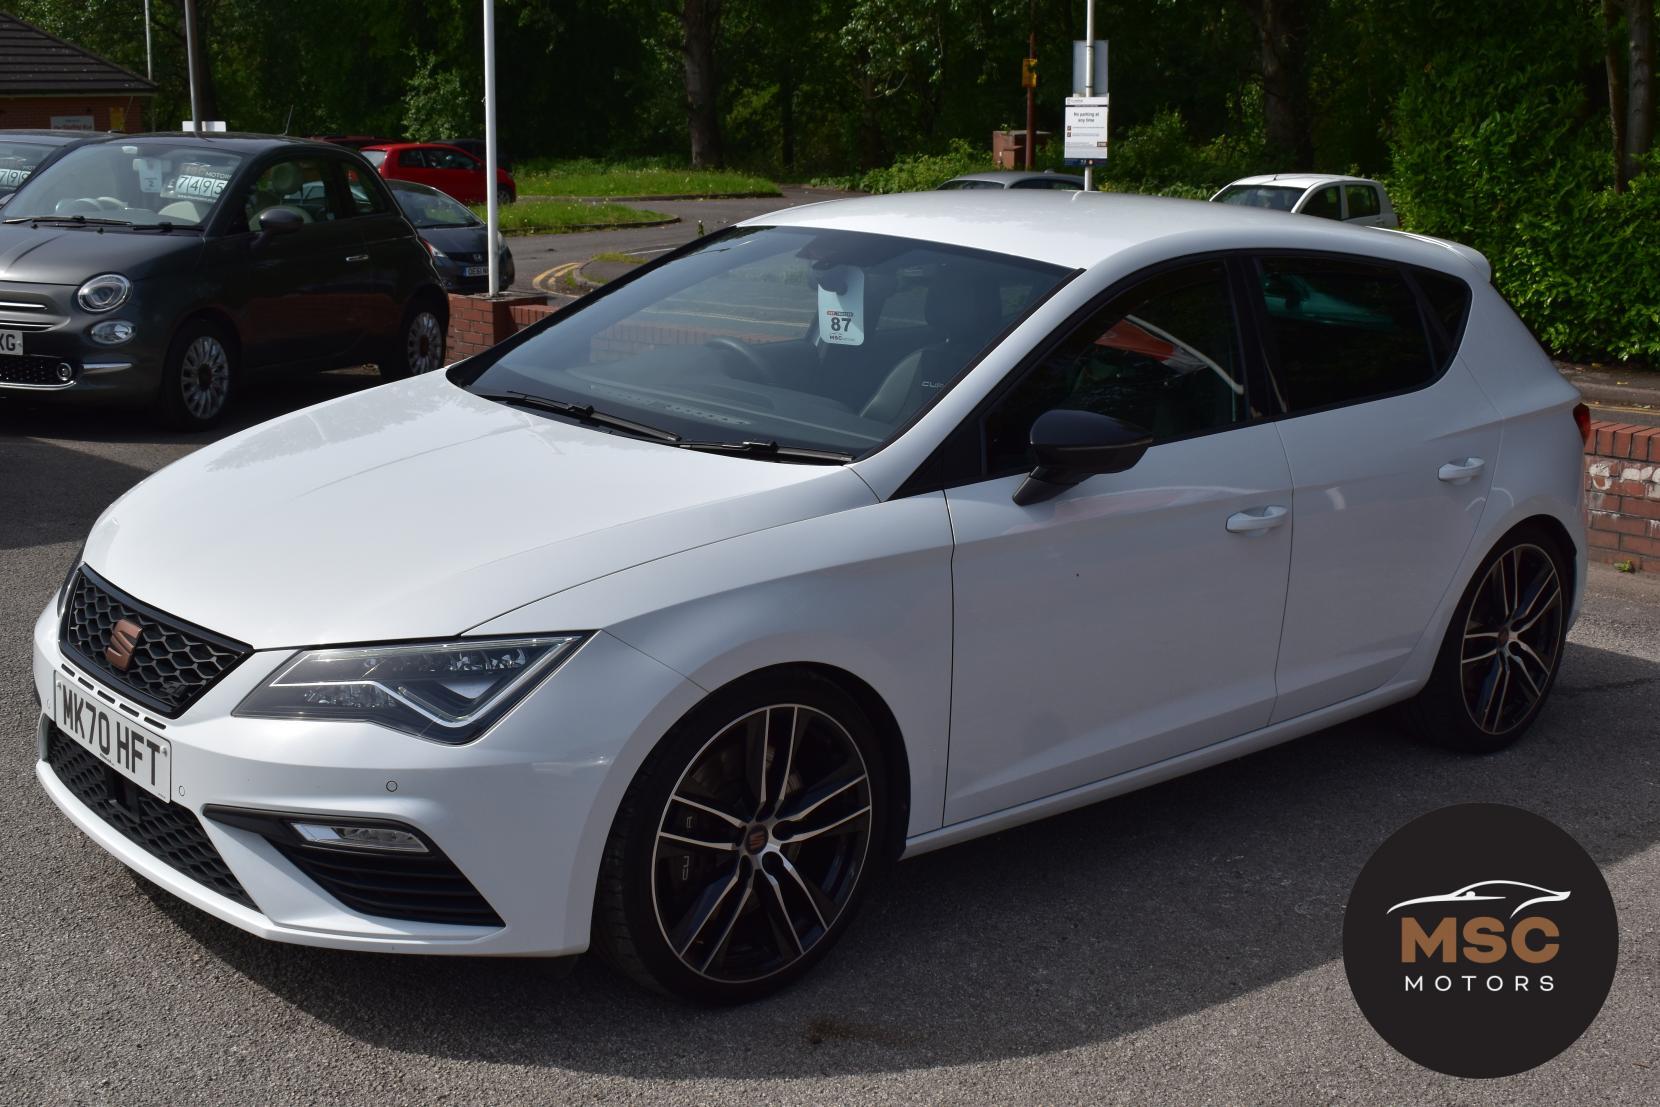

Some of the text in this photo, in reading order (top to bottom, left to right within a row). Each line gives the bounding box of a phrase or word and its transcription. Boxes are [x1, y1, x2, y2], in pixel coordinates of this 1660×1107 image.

[831, 317, 851, 332] 87
[62, 684, 161, 786] MK70 HFT
